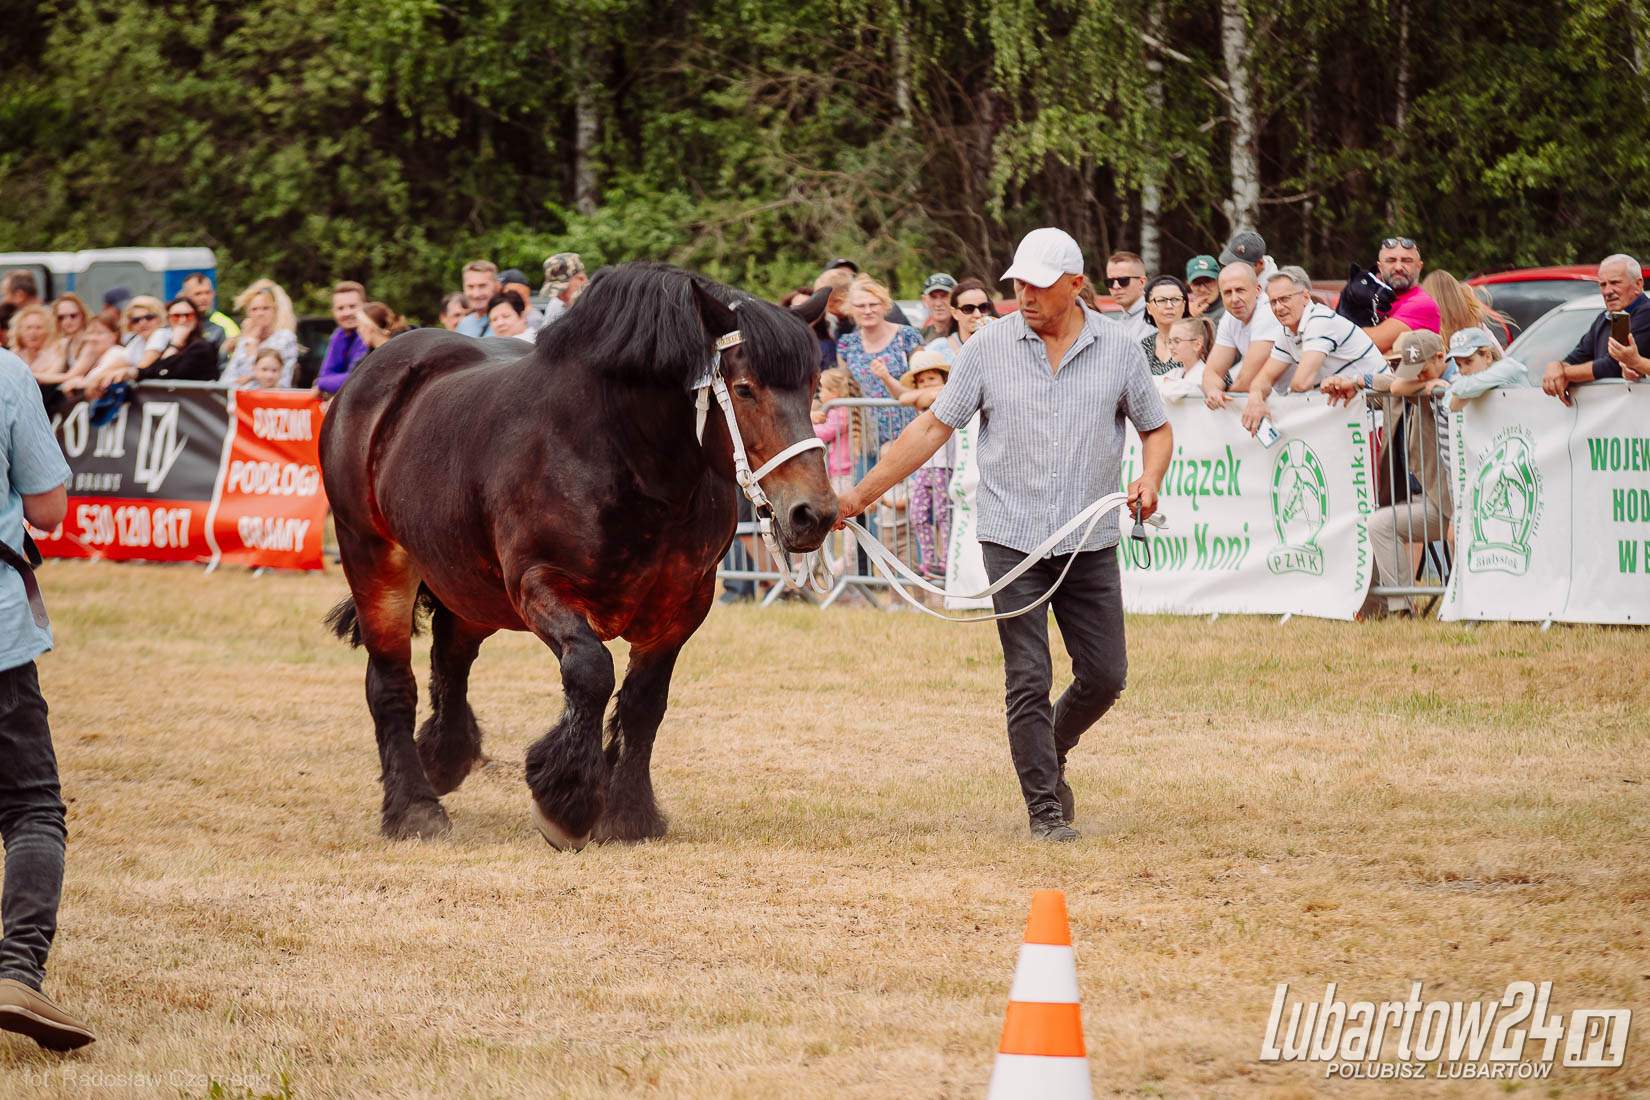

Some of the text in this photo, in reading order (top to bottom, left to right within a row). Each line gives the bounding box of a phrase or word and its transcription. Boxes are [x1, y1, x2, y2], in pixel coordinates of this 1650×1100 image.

[77, 504, 193, 549] 530 120 817
[1347, 422, 1371, 593] www.pzhk.pl
[1193, 522, 1250, 571] Koni
[1273, 552, 1318, 575] PZHK
[1618, 540, 1637, 573] W
